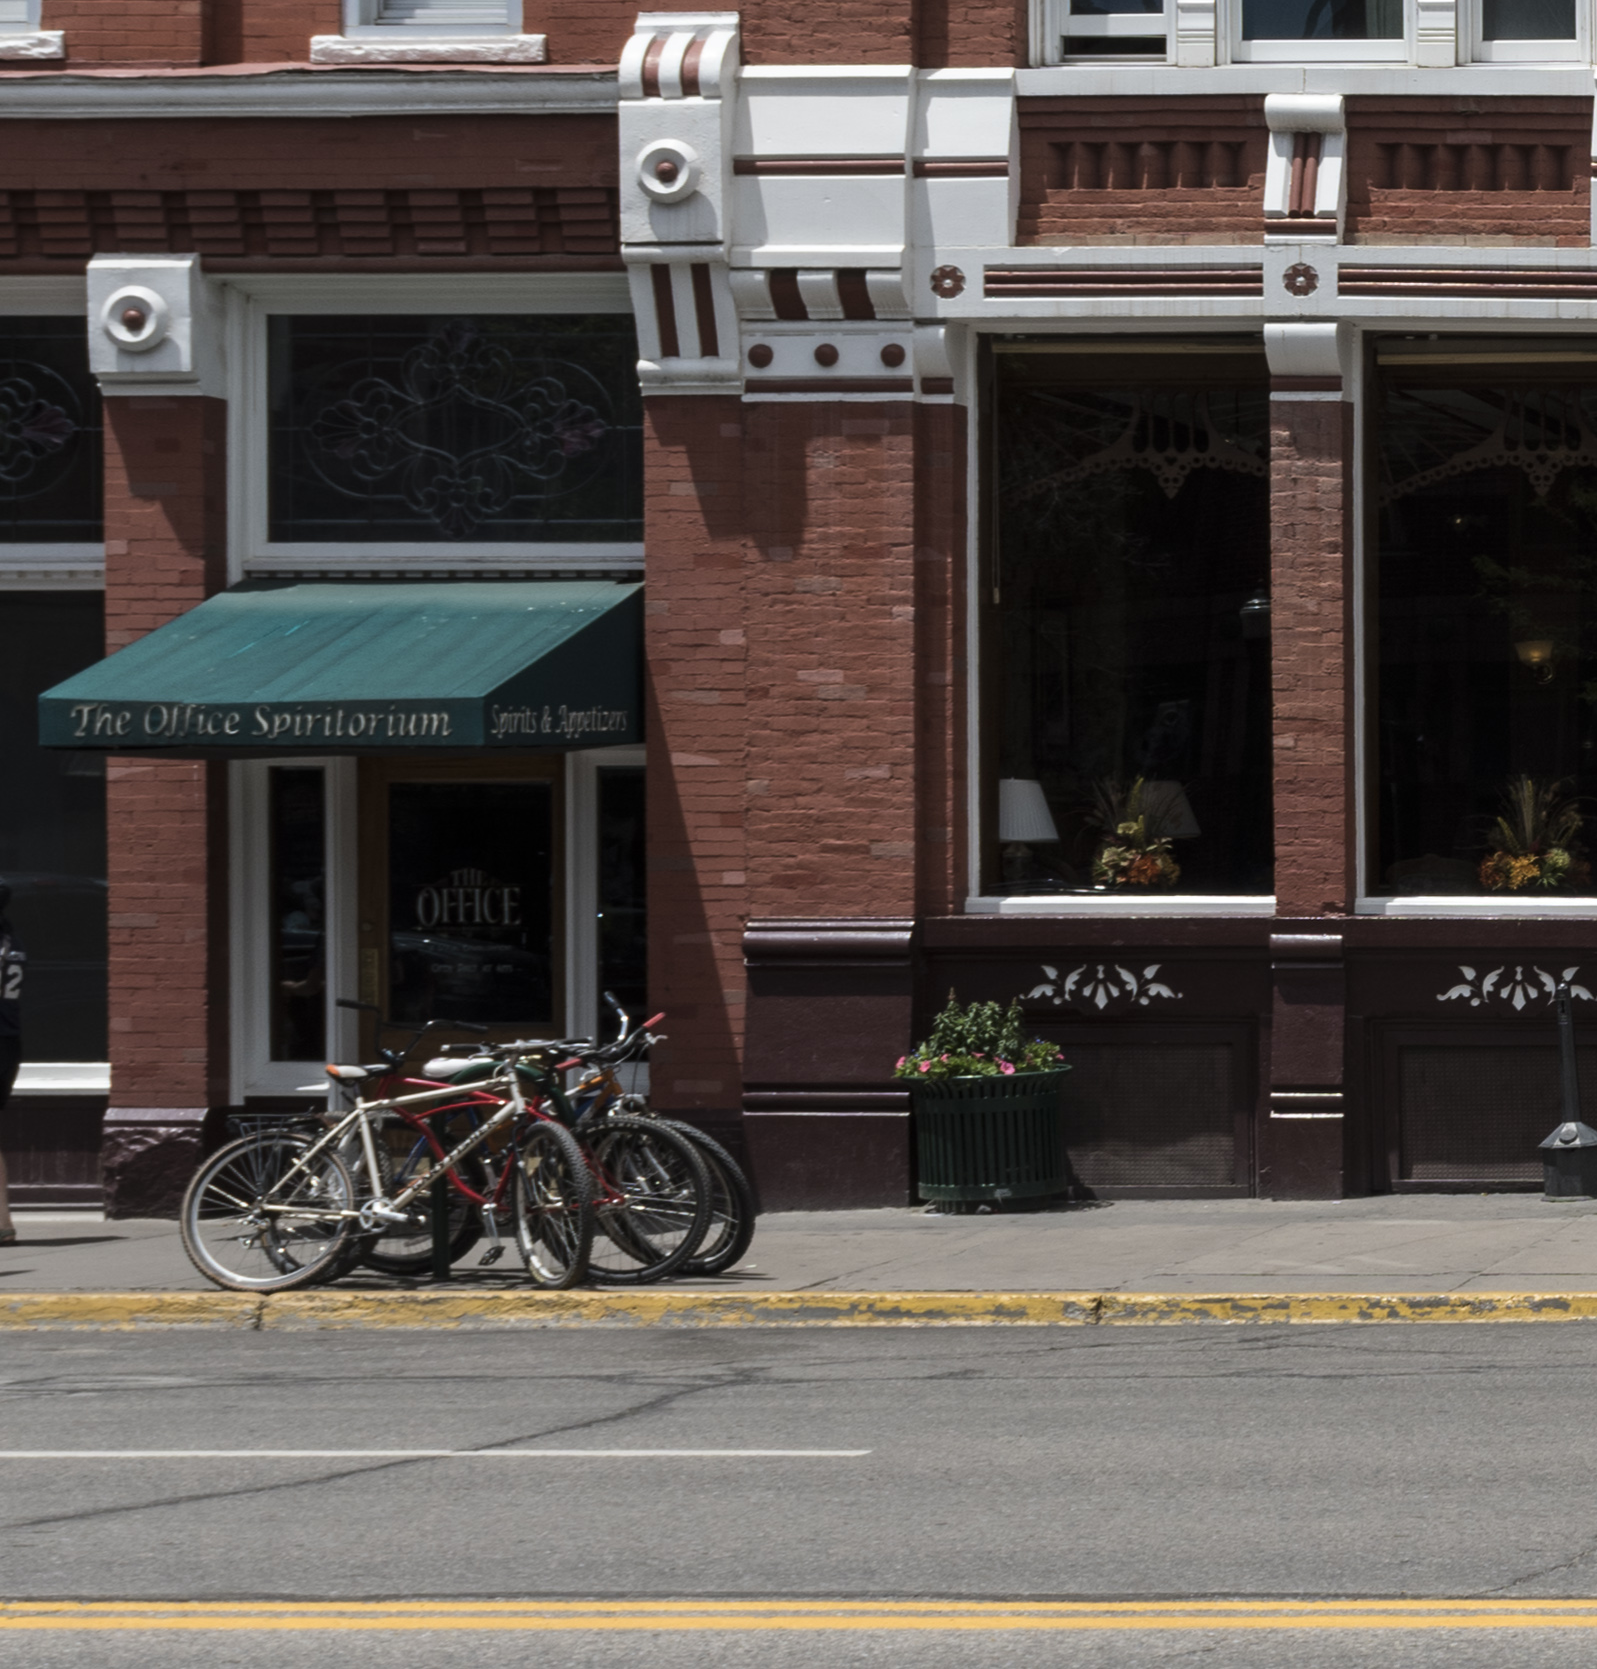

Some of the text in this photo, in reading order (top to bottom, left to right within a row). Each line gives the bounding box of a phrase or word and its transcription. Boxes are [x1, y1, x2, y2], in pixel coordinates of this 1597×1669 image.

[71, 702, 453, 739] The Office Spiritorium
[490, 704, 628, 739] Spirits & Appetizers
[450, 868, 487, 886] THE
[416, 887, 522, 927] OFFICE
